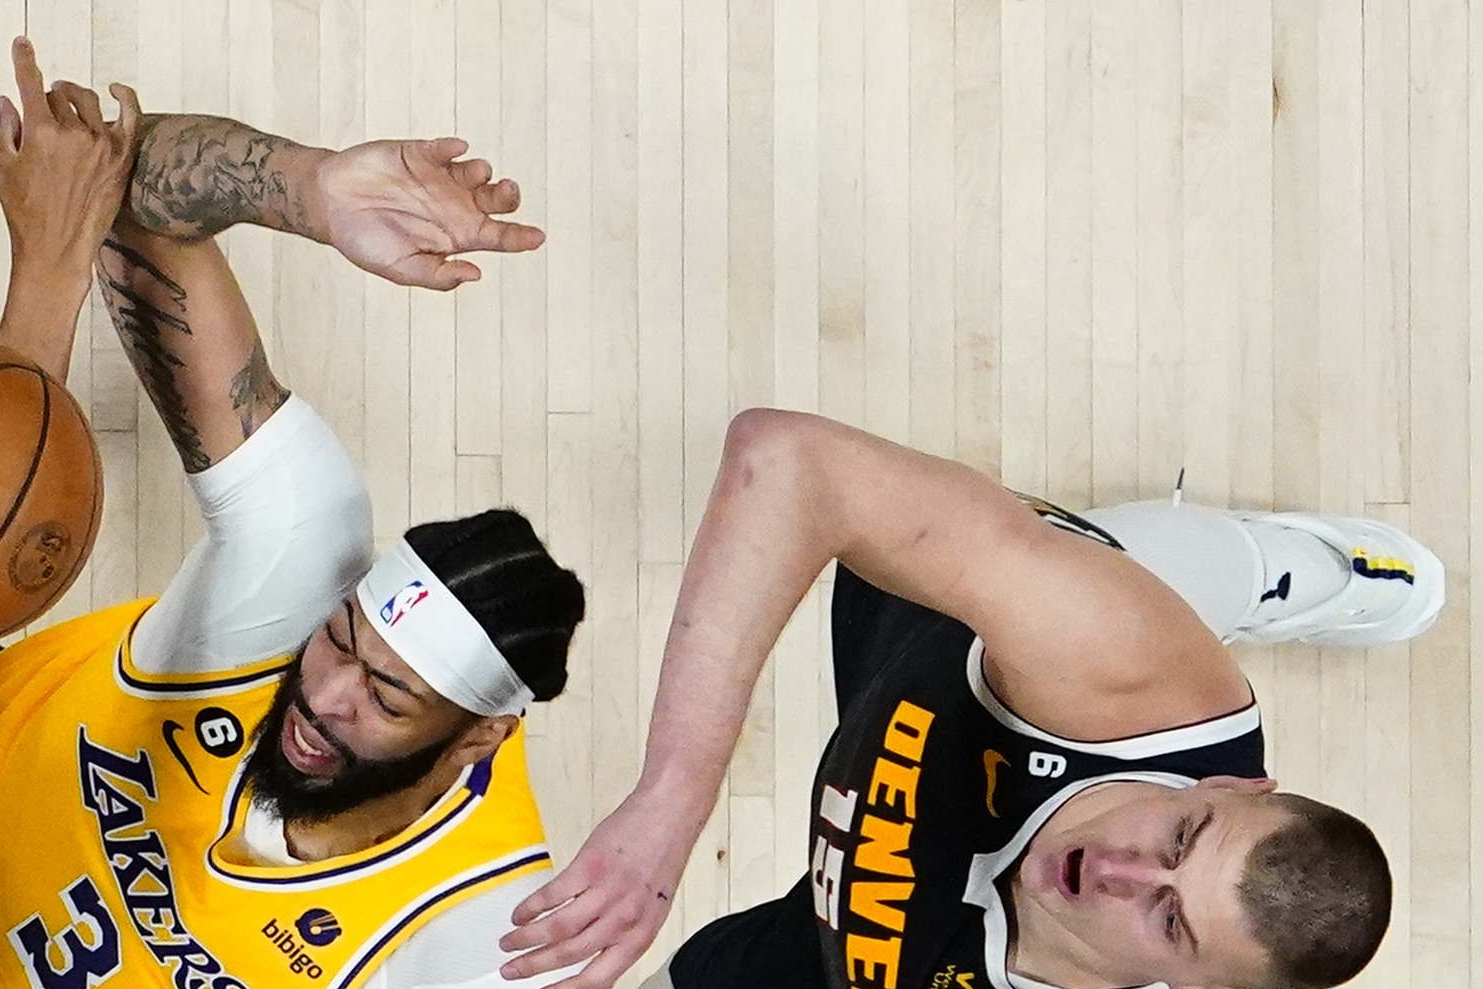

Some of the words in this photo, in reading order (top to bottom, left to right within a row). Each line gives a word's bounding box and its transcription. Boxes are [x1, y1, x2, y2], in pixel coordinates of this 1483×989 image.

[203, 718, 235, 749] 6
[1028, 751, 1067, 778] 6
[813, 783, 859, 933] 15
[262, 918, 324, 980] bibigo
